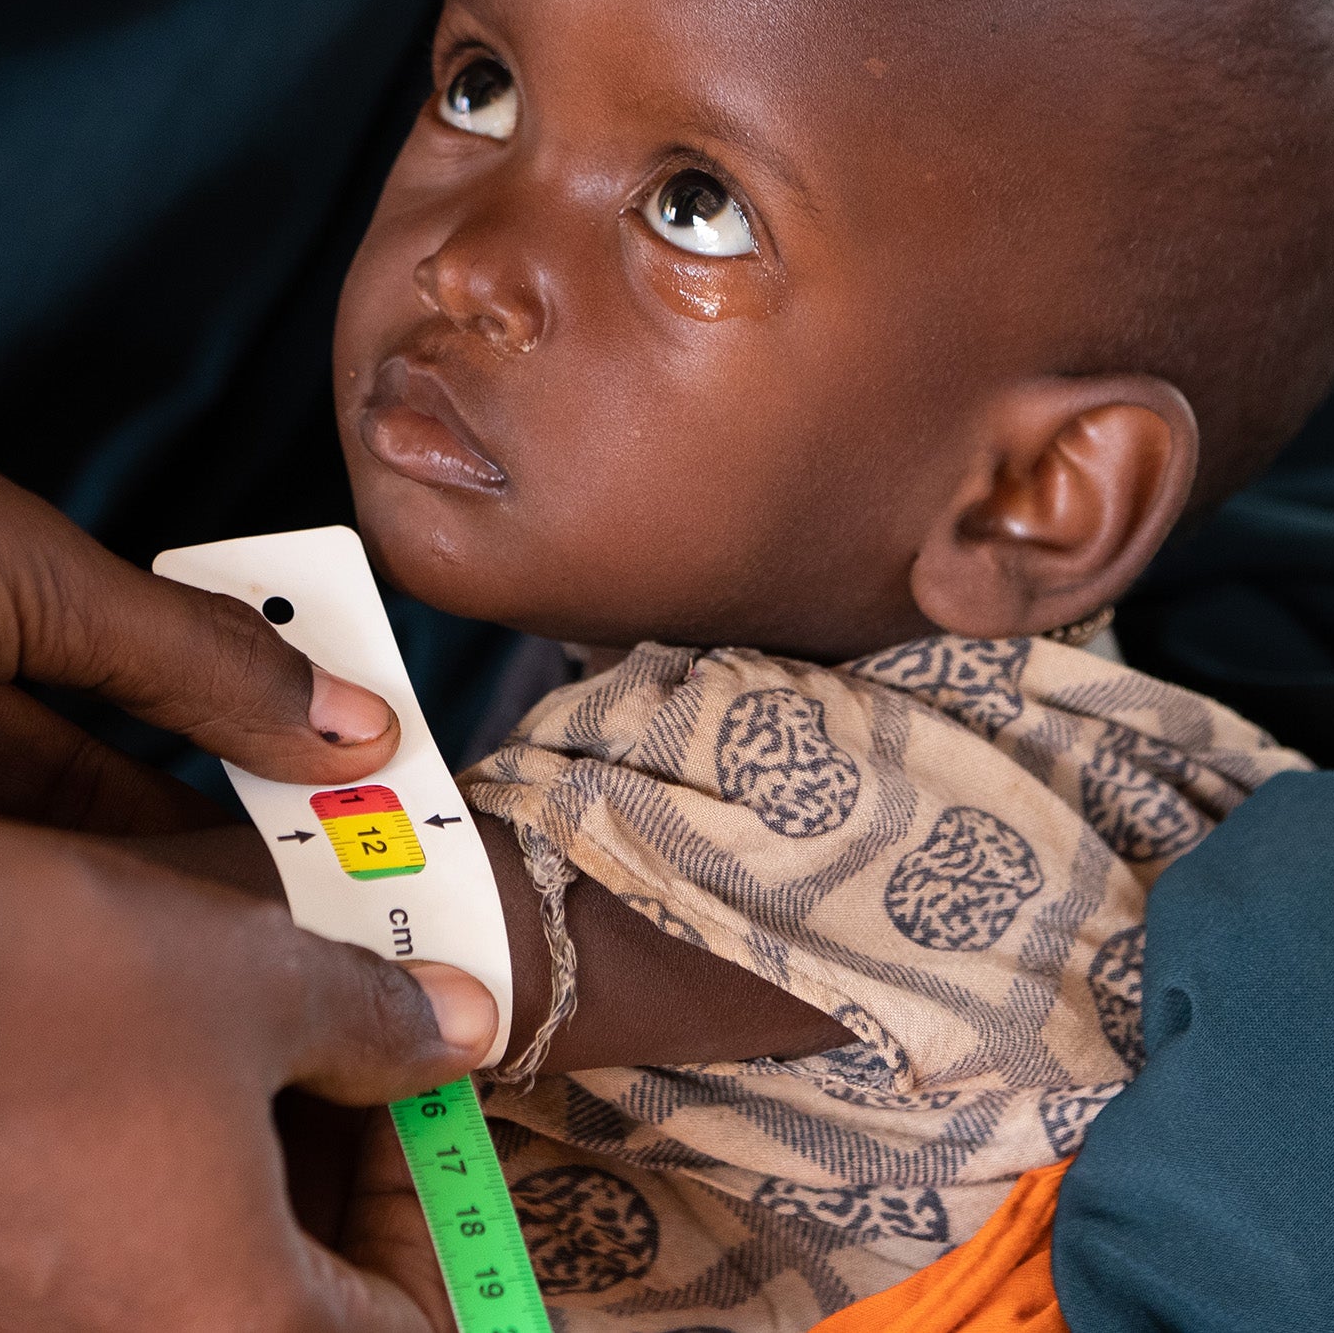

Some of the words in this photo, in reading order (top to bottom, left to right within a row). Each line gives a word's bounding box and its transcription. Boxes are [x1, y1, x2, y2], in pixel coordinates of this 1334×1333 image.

[357, 826, 388, 856] 12
[388, 908, 414, 957] cm
[417, 1088, 447, 1118] 16
[436, 1145, 468, 1176] 17
[455, 1205, 486, 1238] 18
[474, 1266, 505, 1300] 19
